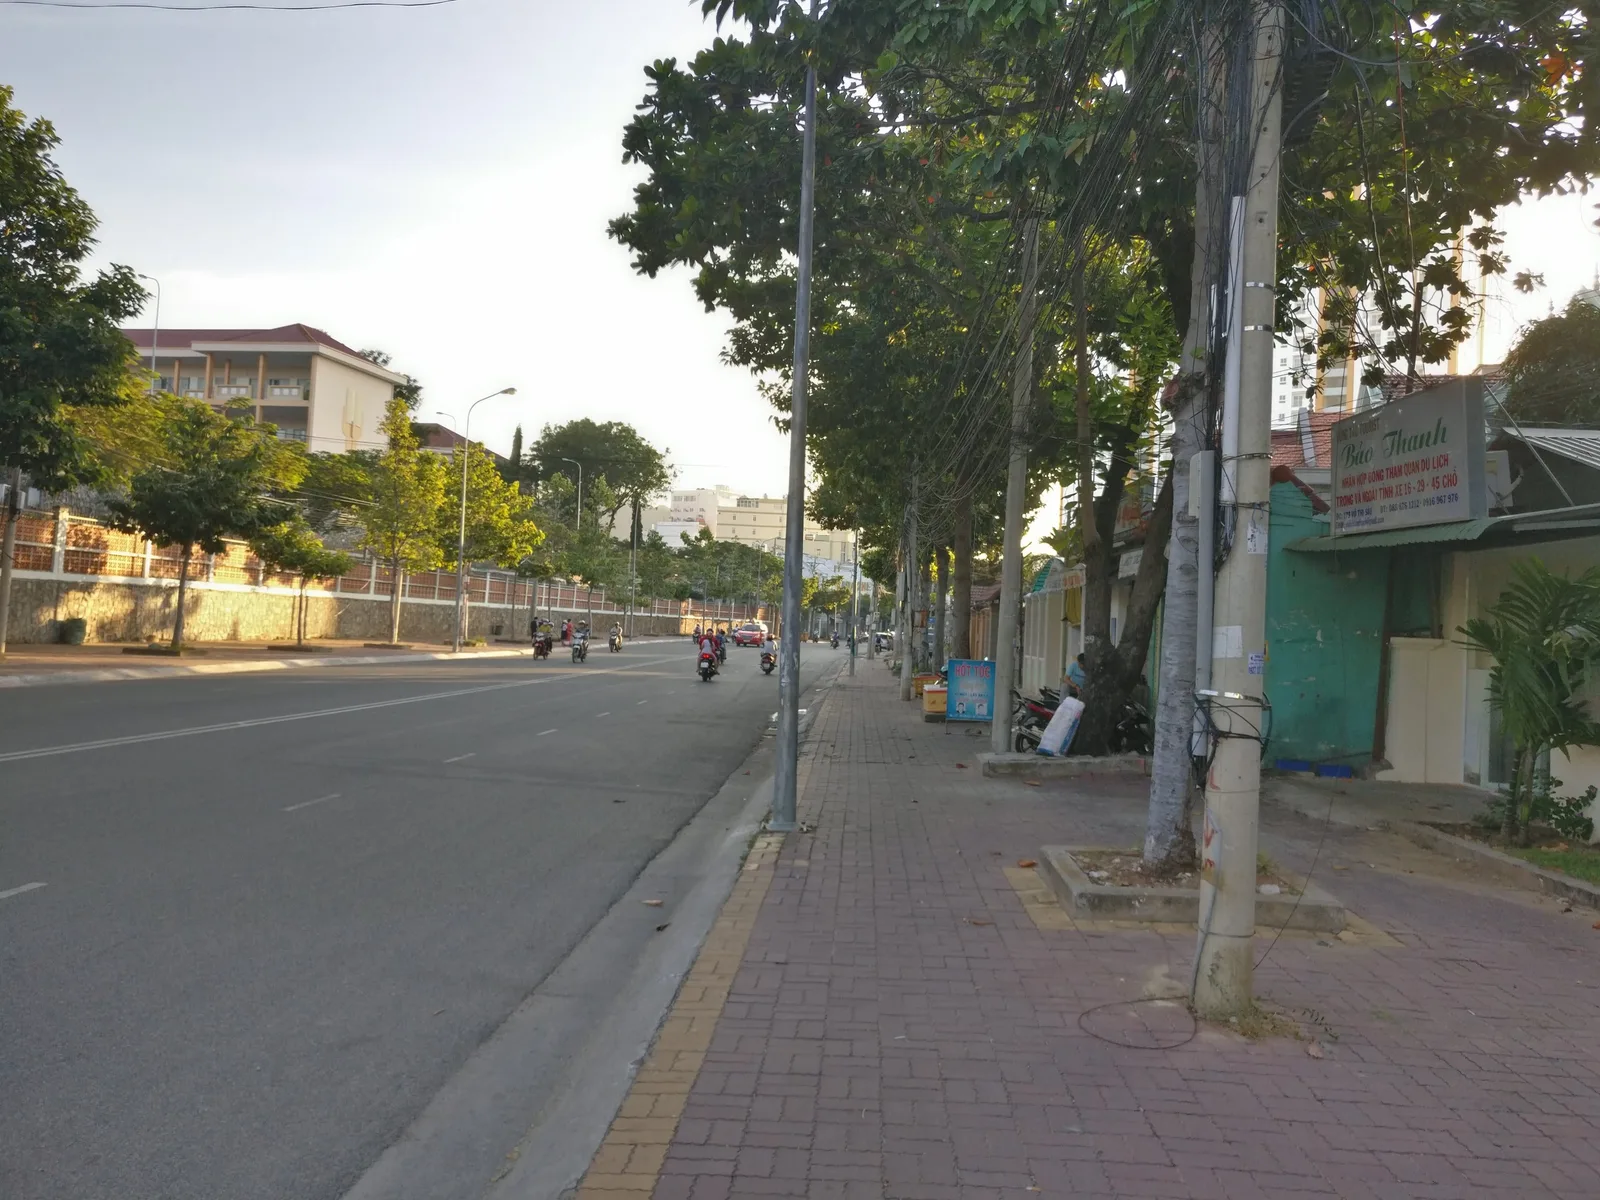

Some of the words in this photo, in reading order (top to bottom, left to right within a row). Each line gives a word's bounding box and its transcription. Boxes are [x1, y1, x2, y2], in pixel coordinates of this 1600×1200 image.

[1341, 440, 1373, 468] Bảo
[1383, 417, 1447, 458] Thanh
[1342, 474, 1355, 489] NHẬN
[1385, 464, 1402, 479] THAM
[1403, 459, 1419, 476] QUAN
[1420, 457, 1430, 472] DU
[1432, 453, 1449, 472] LỊCH
[1336, 493, 1353, 507] TRONG
[1354, 490, 1361, 504] VÀ
[1361, 487, 1376, 502] NGOÀI
[1379, 482, 1392, 499] TỈNH
[1394, 483, 1402, 496] XE
[1404, 482, 1411, 494] 16
[1416, 478, 1424, 492] 29
[1431, 475, 1440, 490] 45
